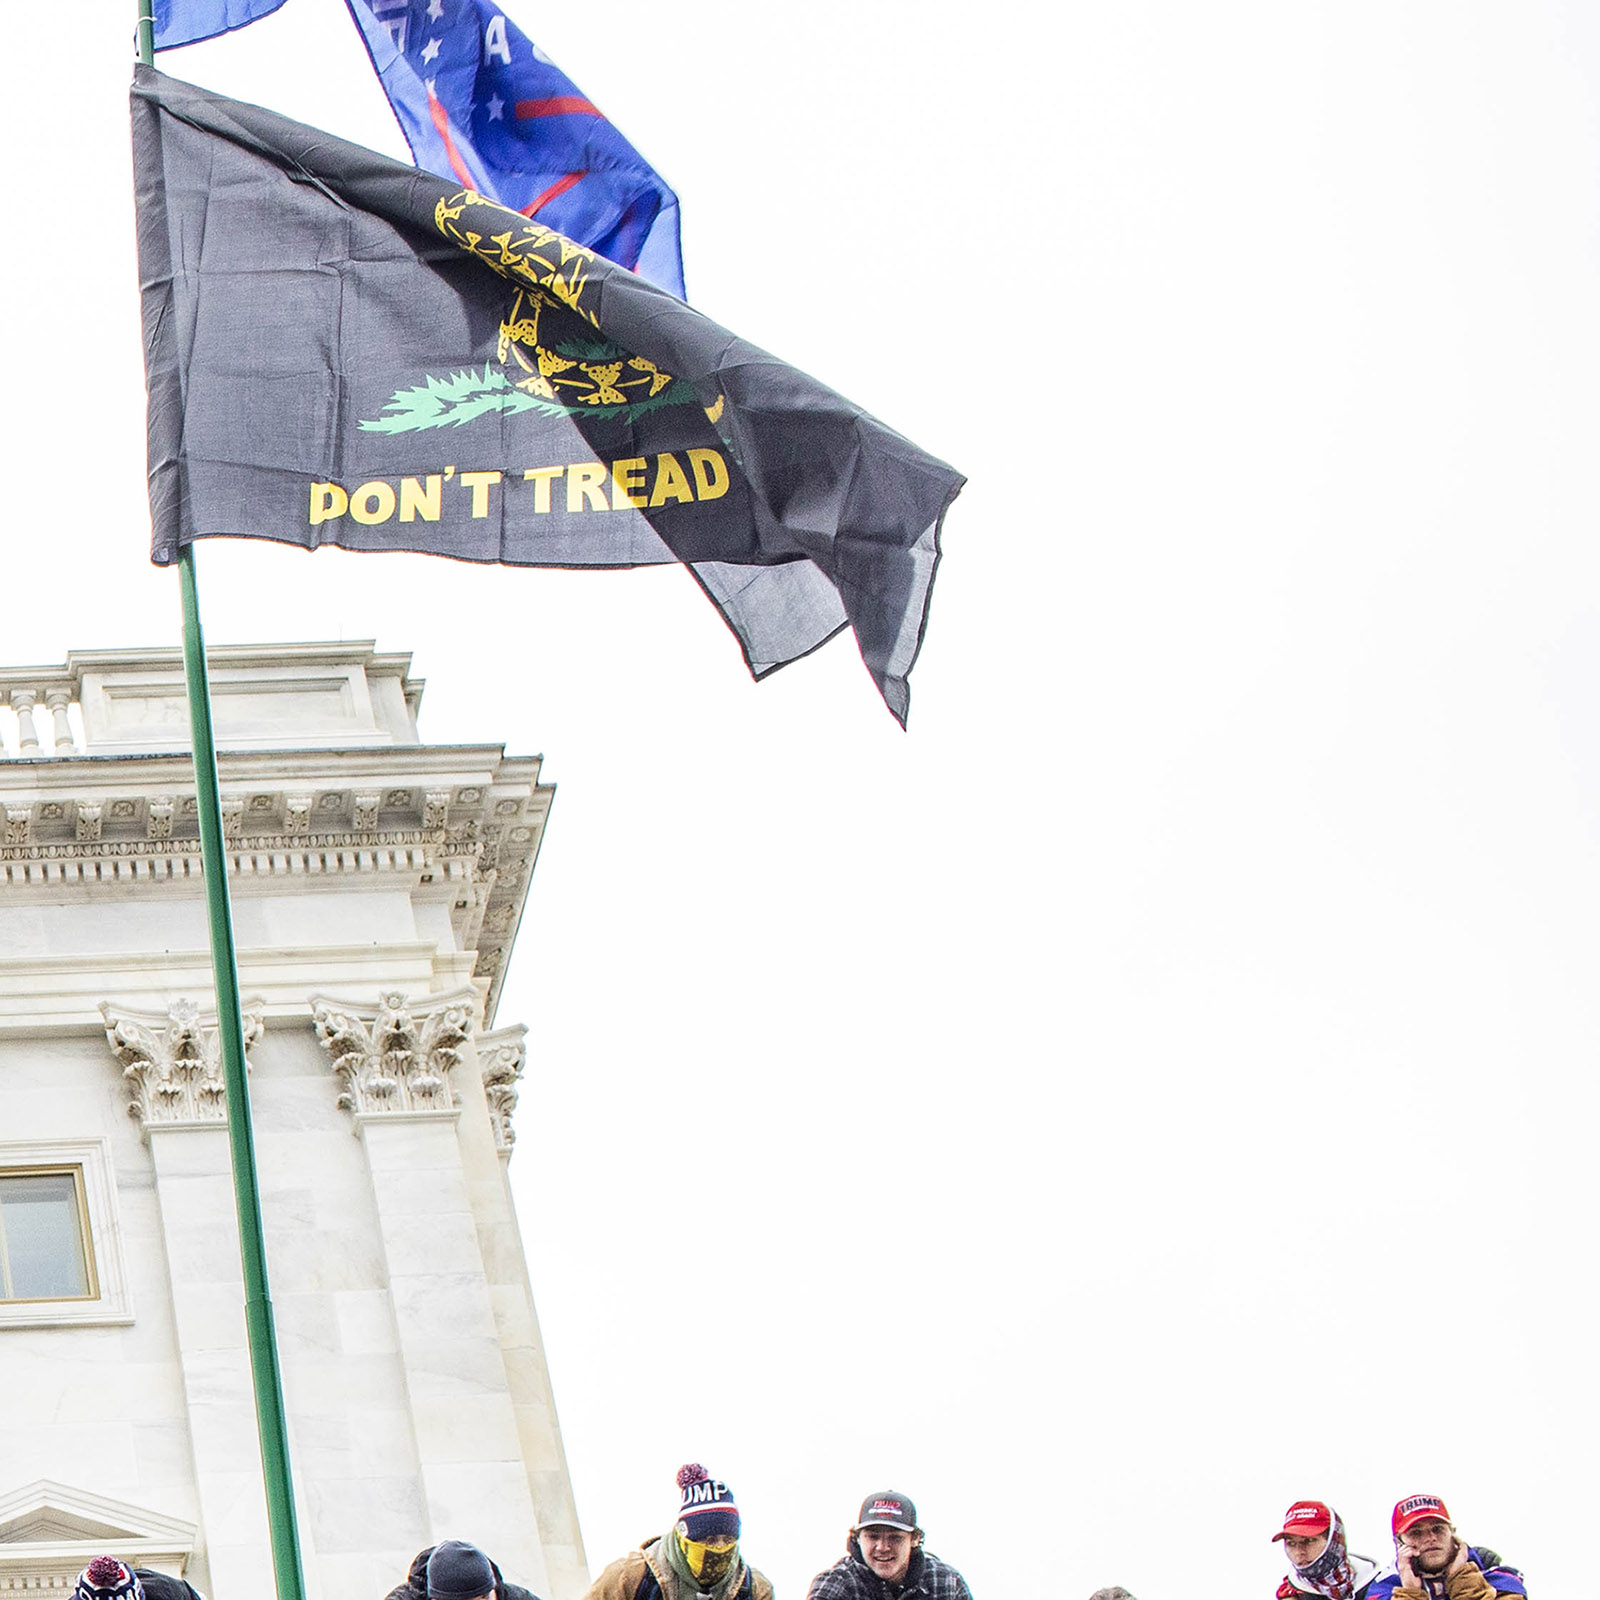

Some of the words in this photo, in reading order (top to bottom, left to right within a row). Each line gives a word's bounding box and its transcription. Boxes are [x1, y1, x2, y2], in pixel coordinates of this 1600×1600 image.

[309, 465, 502, 525] DON'T
[524, 448, 730, 514] TREAD
[1400, 1497, 1441, 1513] TRUMP
